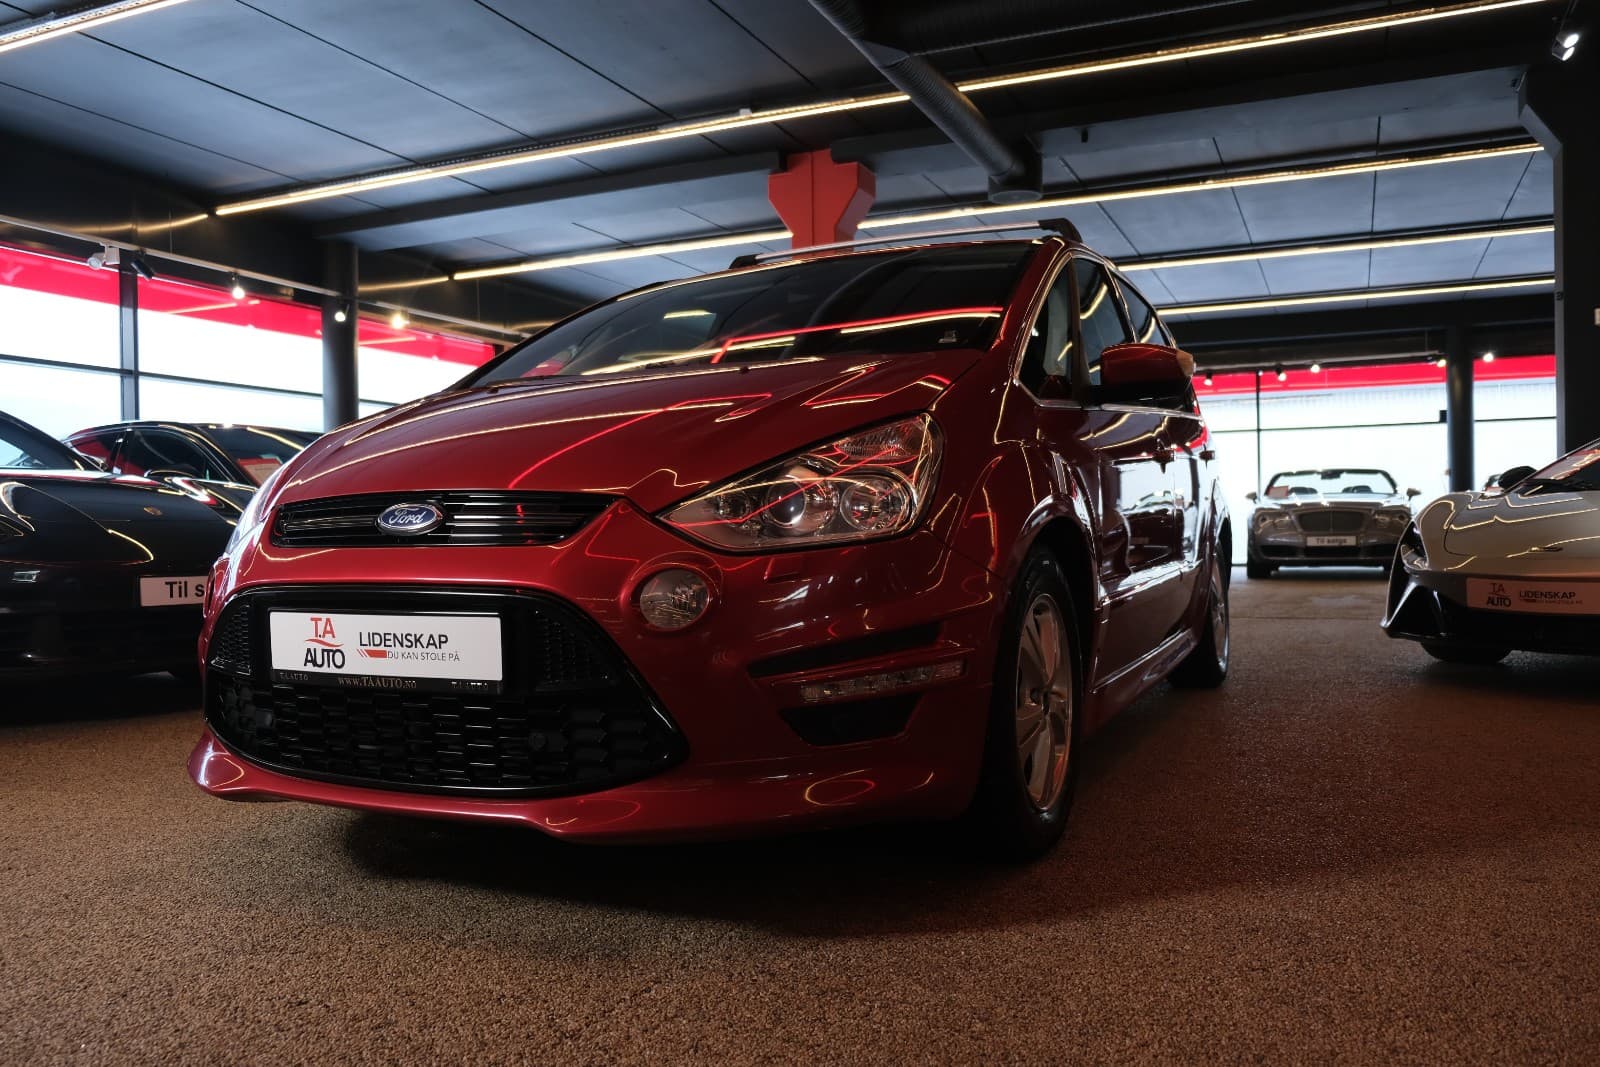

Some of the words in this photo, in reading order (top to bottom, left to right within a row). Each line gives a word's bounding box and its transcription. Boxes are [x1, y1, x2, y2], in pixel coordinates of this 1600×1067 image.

[388, 507, 428, 524] Ford
[165, 581, 188, 598] Til
[1519, 591, 1576, 600] LIDENSKAP
[1486, 596, 1512, 608] AUTO
[359, 632, 449, 649] LIDENSKAP
[304, 647, 346, 669] AUTO
[387, 650, 399, 659] DU
[401, 652, 418, 661] KAN
[420, 652, 446, 662] STOLE
[448, 651, 461, 662] PÅ
